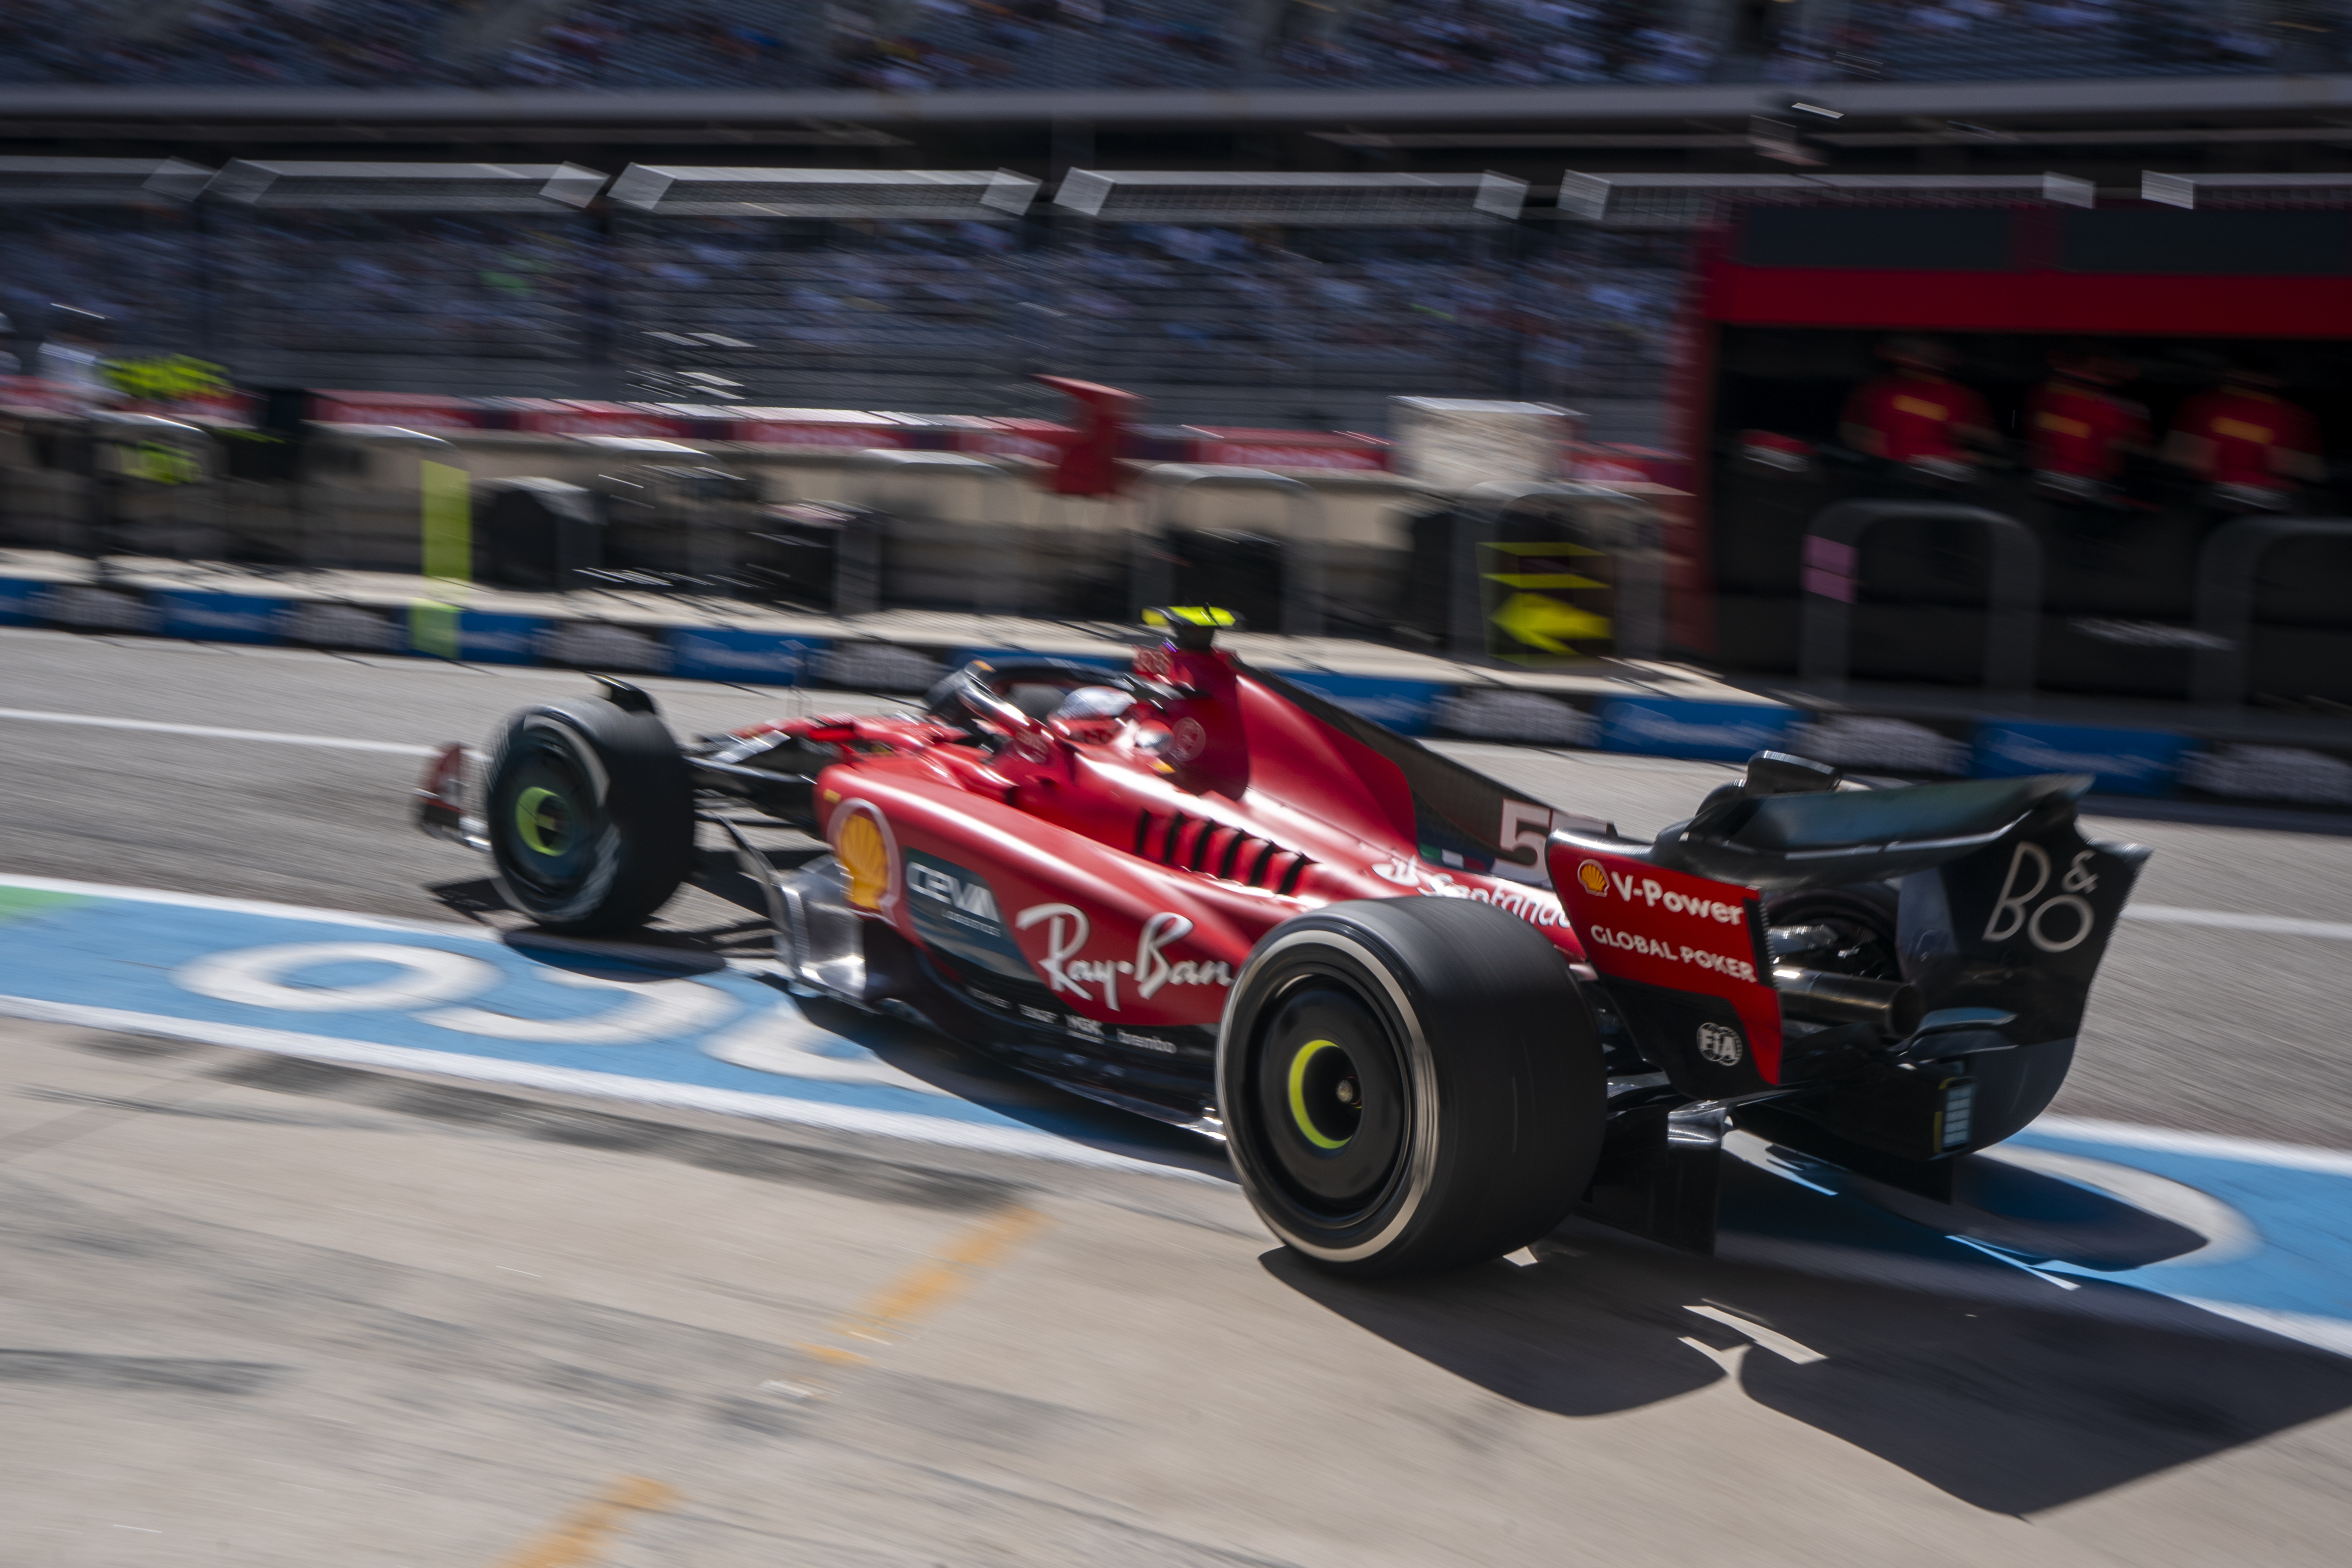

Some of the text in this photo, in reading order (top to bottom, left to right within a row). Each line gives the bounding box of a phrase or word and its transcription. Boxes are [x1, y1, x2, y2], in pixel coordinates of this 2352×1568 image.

[906, 861, 1002, 923] CEVA
[1611, 871, 1745, 926] V-Power
[1015, 903, 1235, 1011] Ray-Ban
[1590, 924, 1757, 983] GLOBAL POKER
[1116, 1028, 1177, 1054] brembo
[1698, 1026, 1739, 1061] FIA
